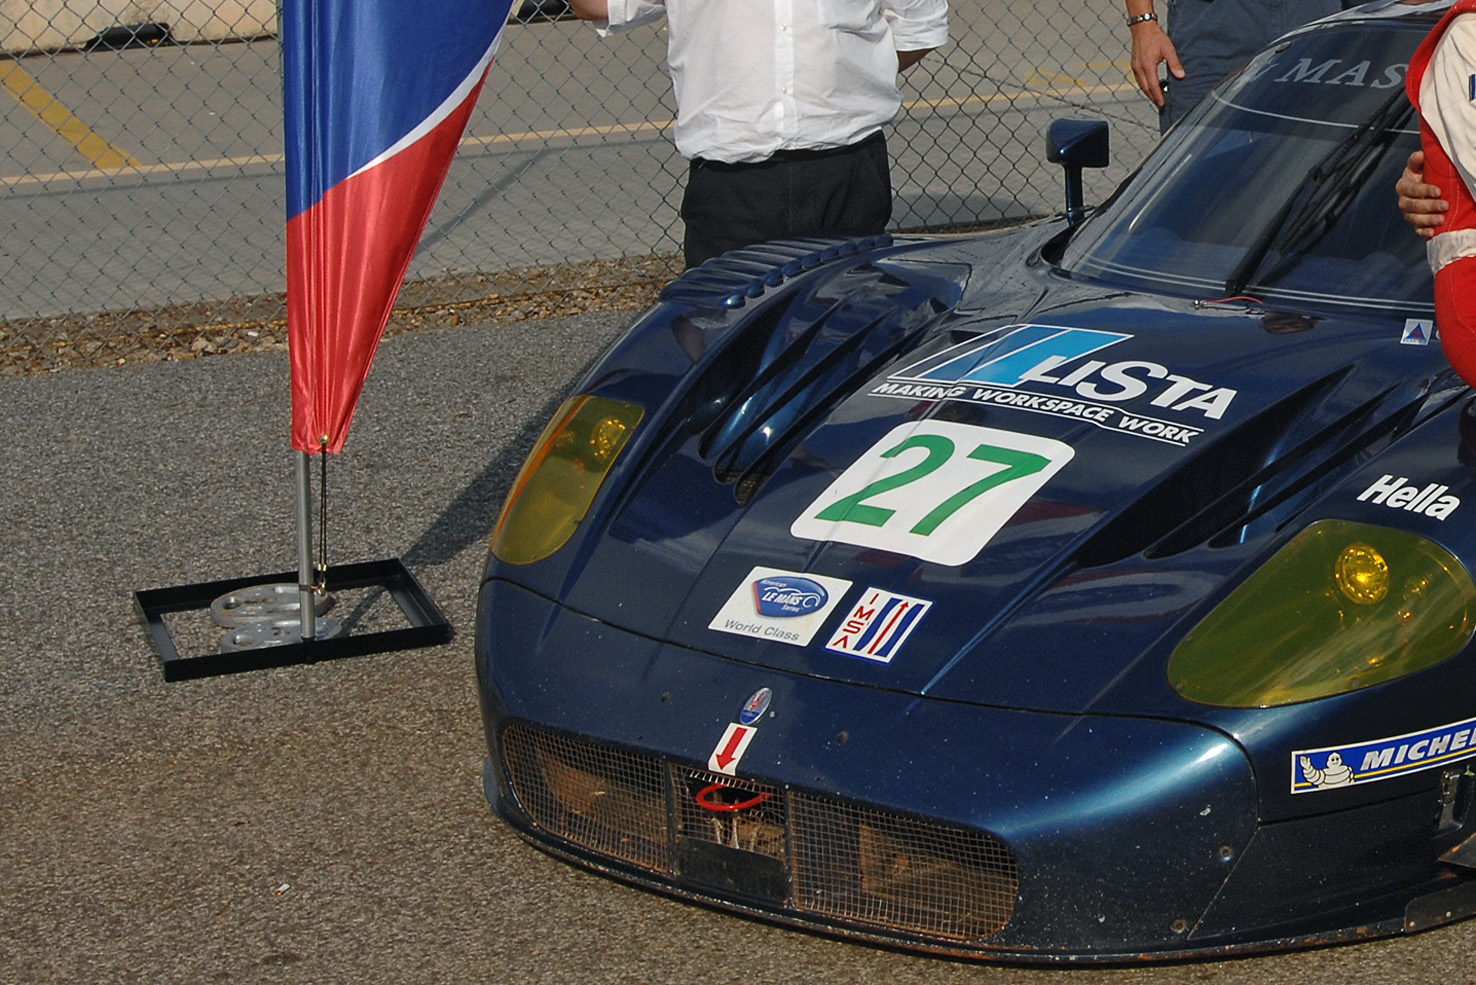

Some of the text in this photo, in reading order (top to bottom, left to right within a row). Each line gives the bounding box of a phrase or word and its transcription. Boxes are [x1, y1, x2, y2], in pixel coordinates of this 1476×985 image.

[872, 382, 1200, 444] MAKING WORKSPACE WORK
[1018, 355, 1238, 420] LISTA
[813, 434, 1052, 536] 27
[1356, 474, 1461, 521] Hella
[762, 592, 777, 602] LE
[833, 593, 879, 649] IMSA
[725, 619, 800, 641] World Class
